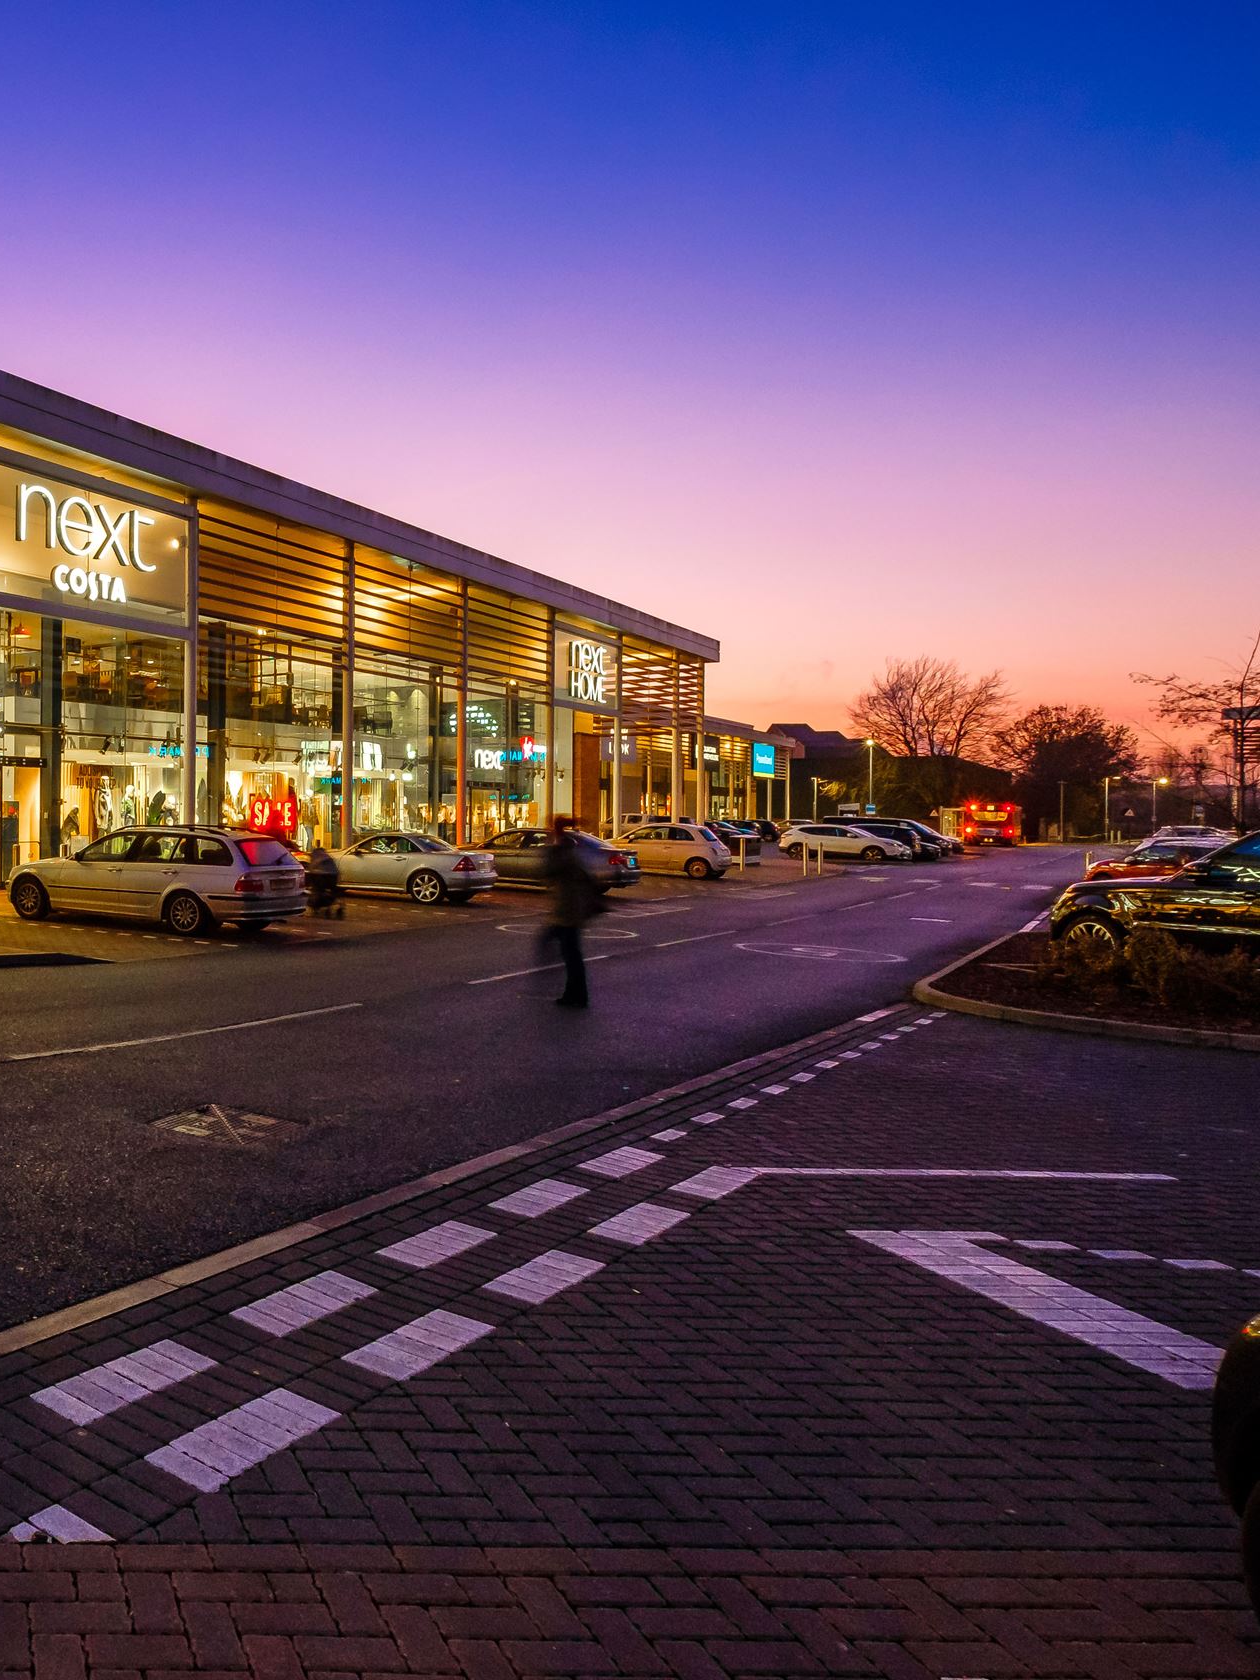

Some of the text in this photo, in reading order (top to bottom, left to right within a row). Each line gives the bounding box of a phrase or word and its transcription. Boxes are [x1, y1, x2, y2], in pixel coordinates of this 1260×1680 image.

[16, 483, 157, 572] next
[51, 564, 127, 602] COSTA
[570, 640, 608, 676] next
[570, 671, 608, 704] HOME
[474, 748, 504, 770] next
[254, 801, 292, 827] SAE
